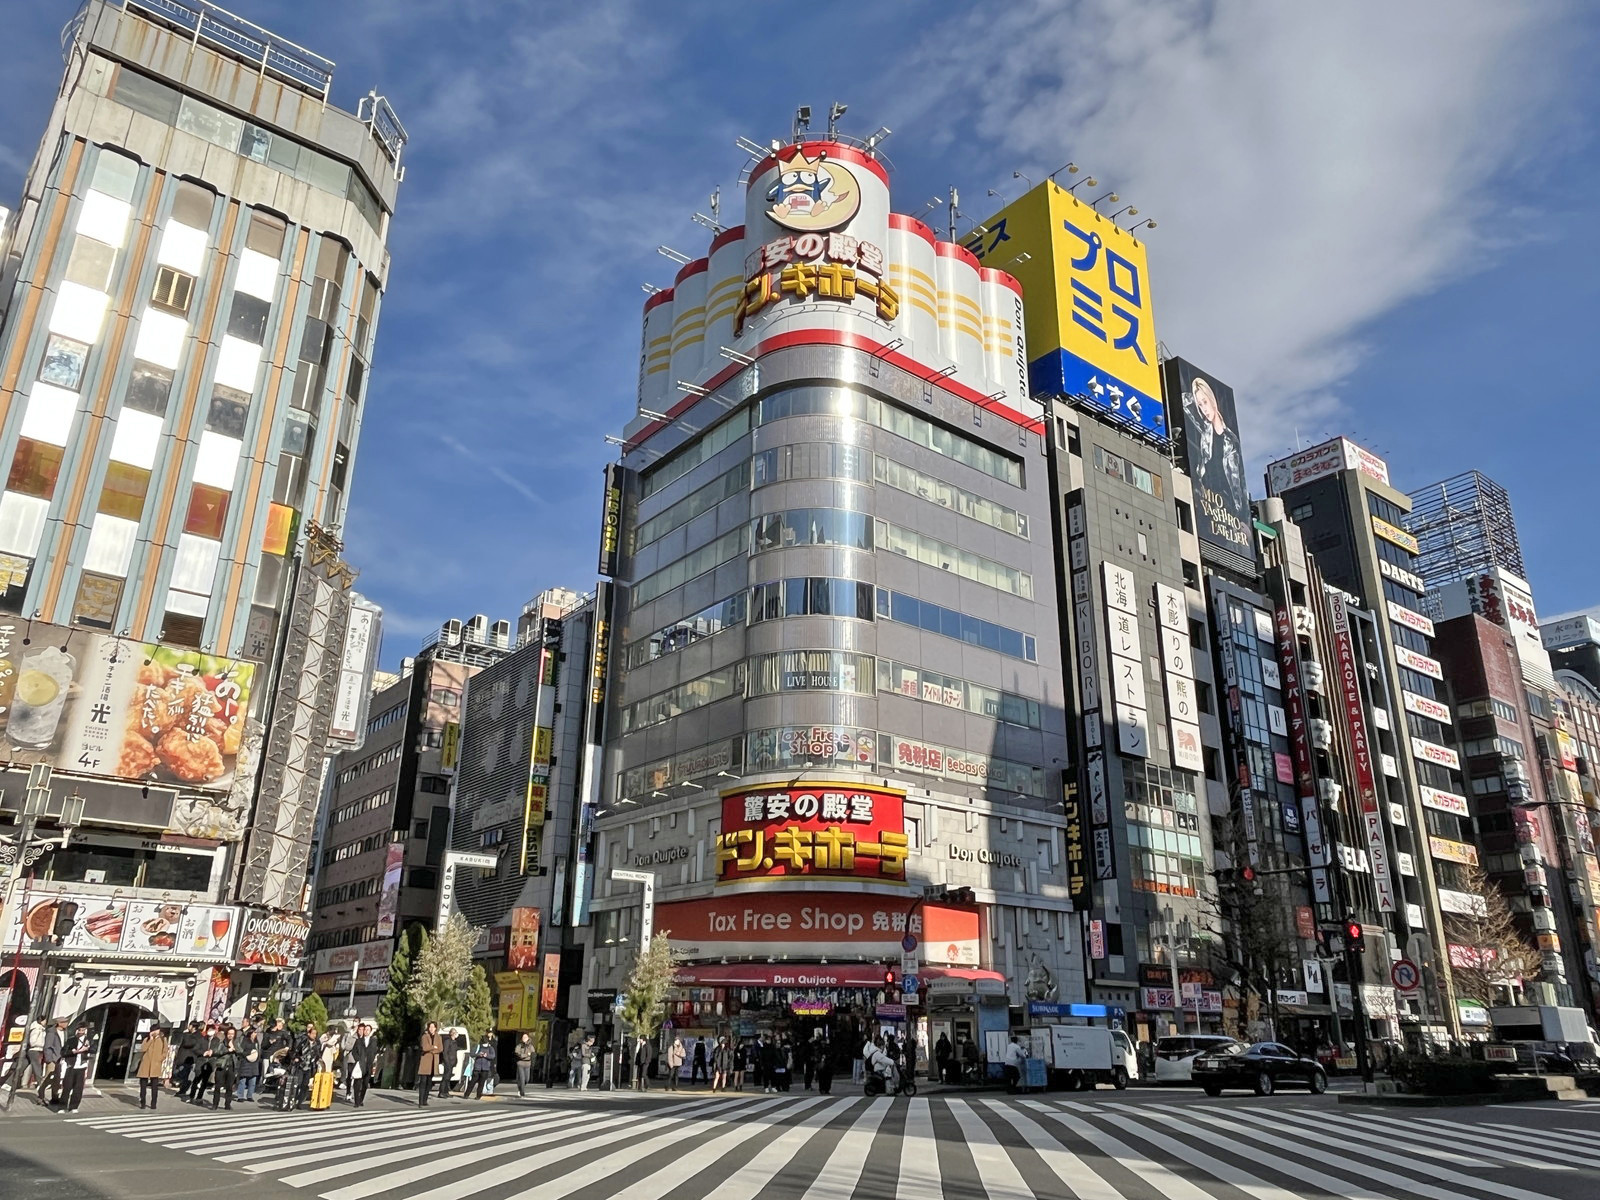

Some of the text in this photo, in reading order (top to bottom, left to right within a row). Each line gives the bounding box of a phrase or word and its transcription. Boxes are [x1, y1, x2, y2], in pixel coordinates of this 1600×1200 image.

[744, 231, 884, 282] 驚安の殿堂
[1014, 296, 1022, 331] Don
[1201, 488, 1223, 508] MIO
[1200, 500, 1241, 532] YASHIRO
[1380, 559, 1425, 593] DARTS
[1333, 596, 1343, 621] 300
[1078, 609, 1093, 704] KIBORI
[1114, 571, 1141, 749] 北海道レストラン
[1166, 593, 1190, 717] 木彫りの熊の
[787, 675, 806, 687] LIVE
[923, 684, 942, 703] アイドル
[91, 703, 111, 724] 光
[1339, 633, 1356, 702] KARAOKE
[1354, 721, 1368, 772] PARTY
[782, 727, 850, 744] ax Free
[78, 752, 101, 769] 4F
[789, 741, 838, 758] Shop
[898, 742, 943, 772] 免税店
[947, 757, 978, 775] Bebas
[744, 792, 874, 823] 驚安の殿堂
[141, 841, 181, 851] MONJA
[526, 828, 539, 872] CASINO
[633, 846, 688, 867] Don Quijote
[949, 843, 1023, 868] Don Quijote
[1369, 818, 1391, 908] PASELA
[125, 905, 144, 949] おつまみ
[182, 918, 196, 940] お酒
[247, 918, 311, 940] OKONOMIYAKI
[708, 907, 864, 936] Tax Free Shop
[872, 910, 922, 934] 免税店
[246, 936, 300, 959] お好み焼き
[774, 975, 837, 986] Don Quijote
